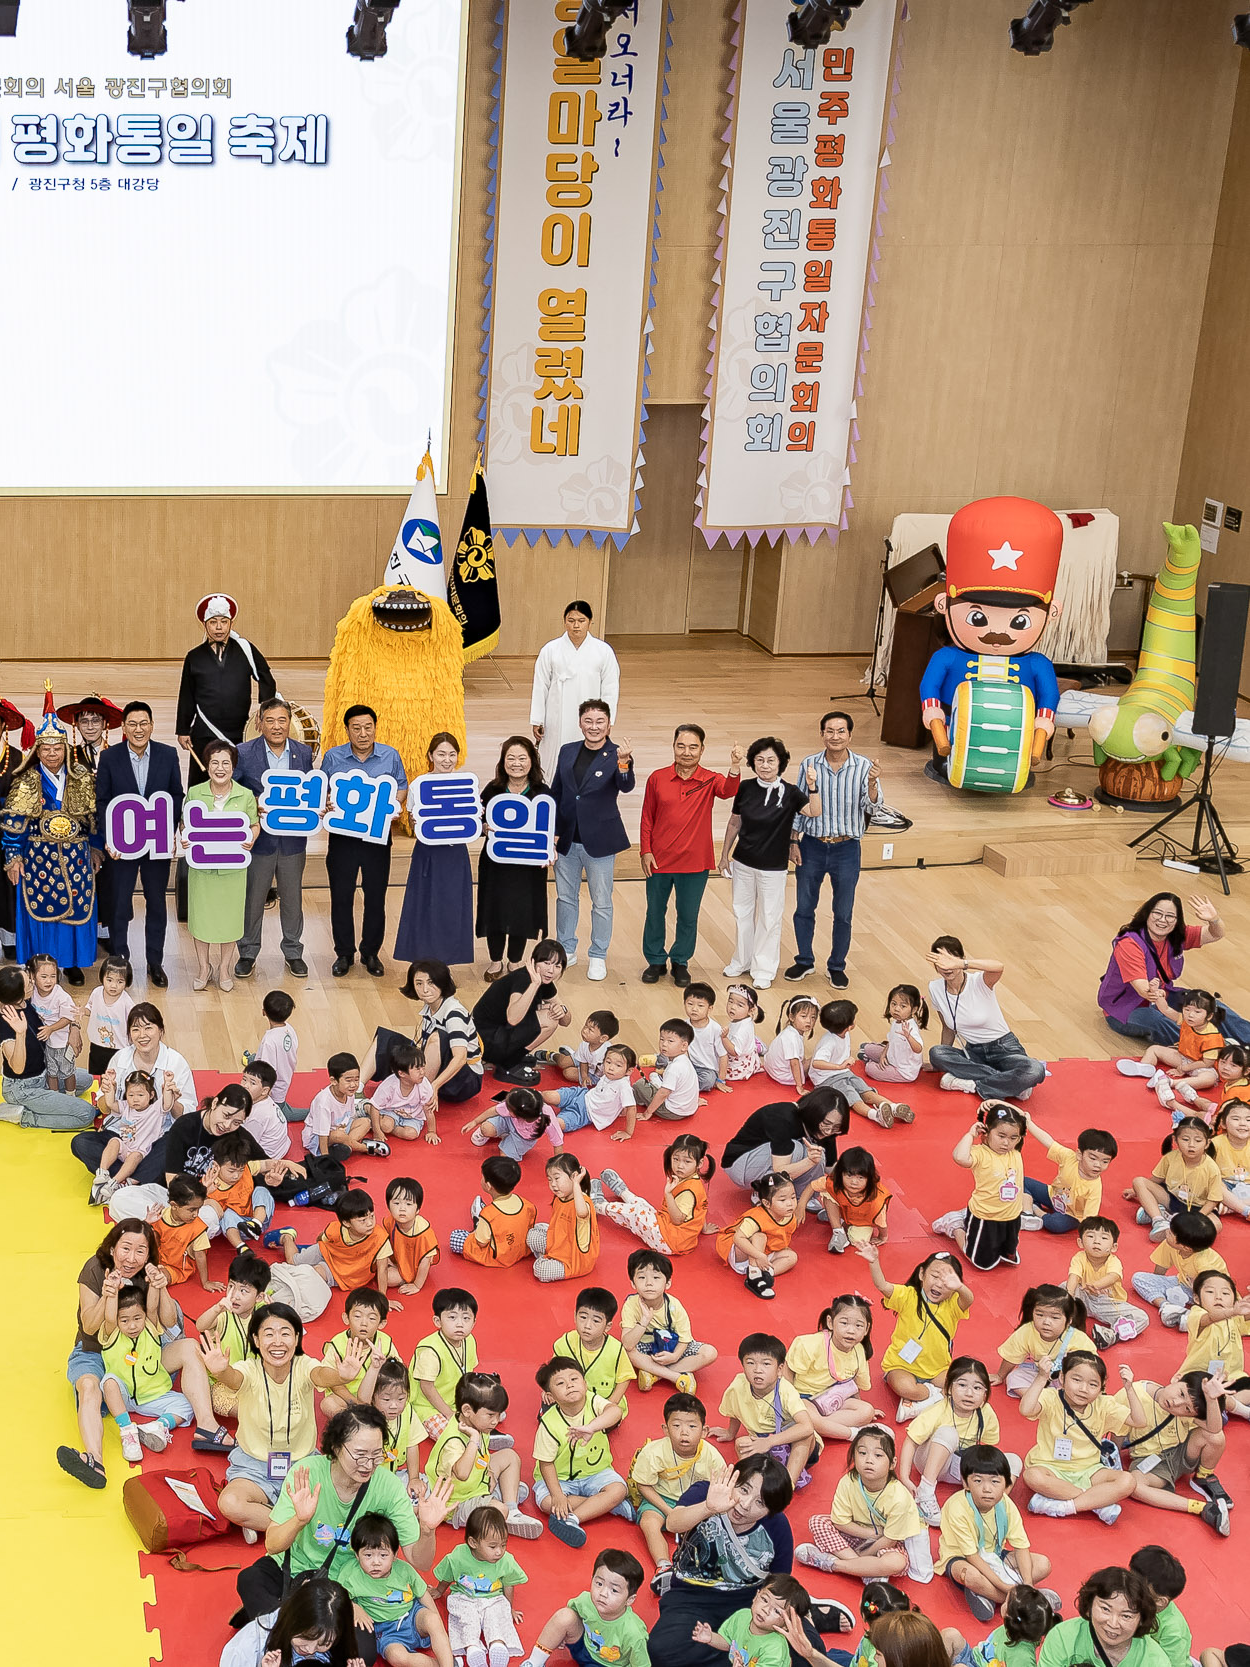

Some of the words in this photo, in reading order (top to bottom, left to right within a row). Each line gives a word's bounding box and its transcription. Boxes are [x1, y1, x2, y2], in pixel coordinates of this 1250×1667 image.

[54, 76, 96, 99] 서울
[104, 76, 232, 100] 광진구협의회
[10, 113, 214, 166] 평화통일
[227, 113, 329, 166] 축제
[28, 177, 85, 191] 광진구청
[90, 177, 112, 191] 5층
[117, 177, 160, 191] 대강당
[785, 47, 855, 452] 민주평화통일자문회의
[529, 287, 587, 457] 열렸네
[111, 797, 247, 864] 여는
